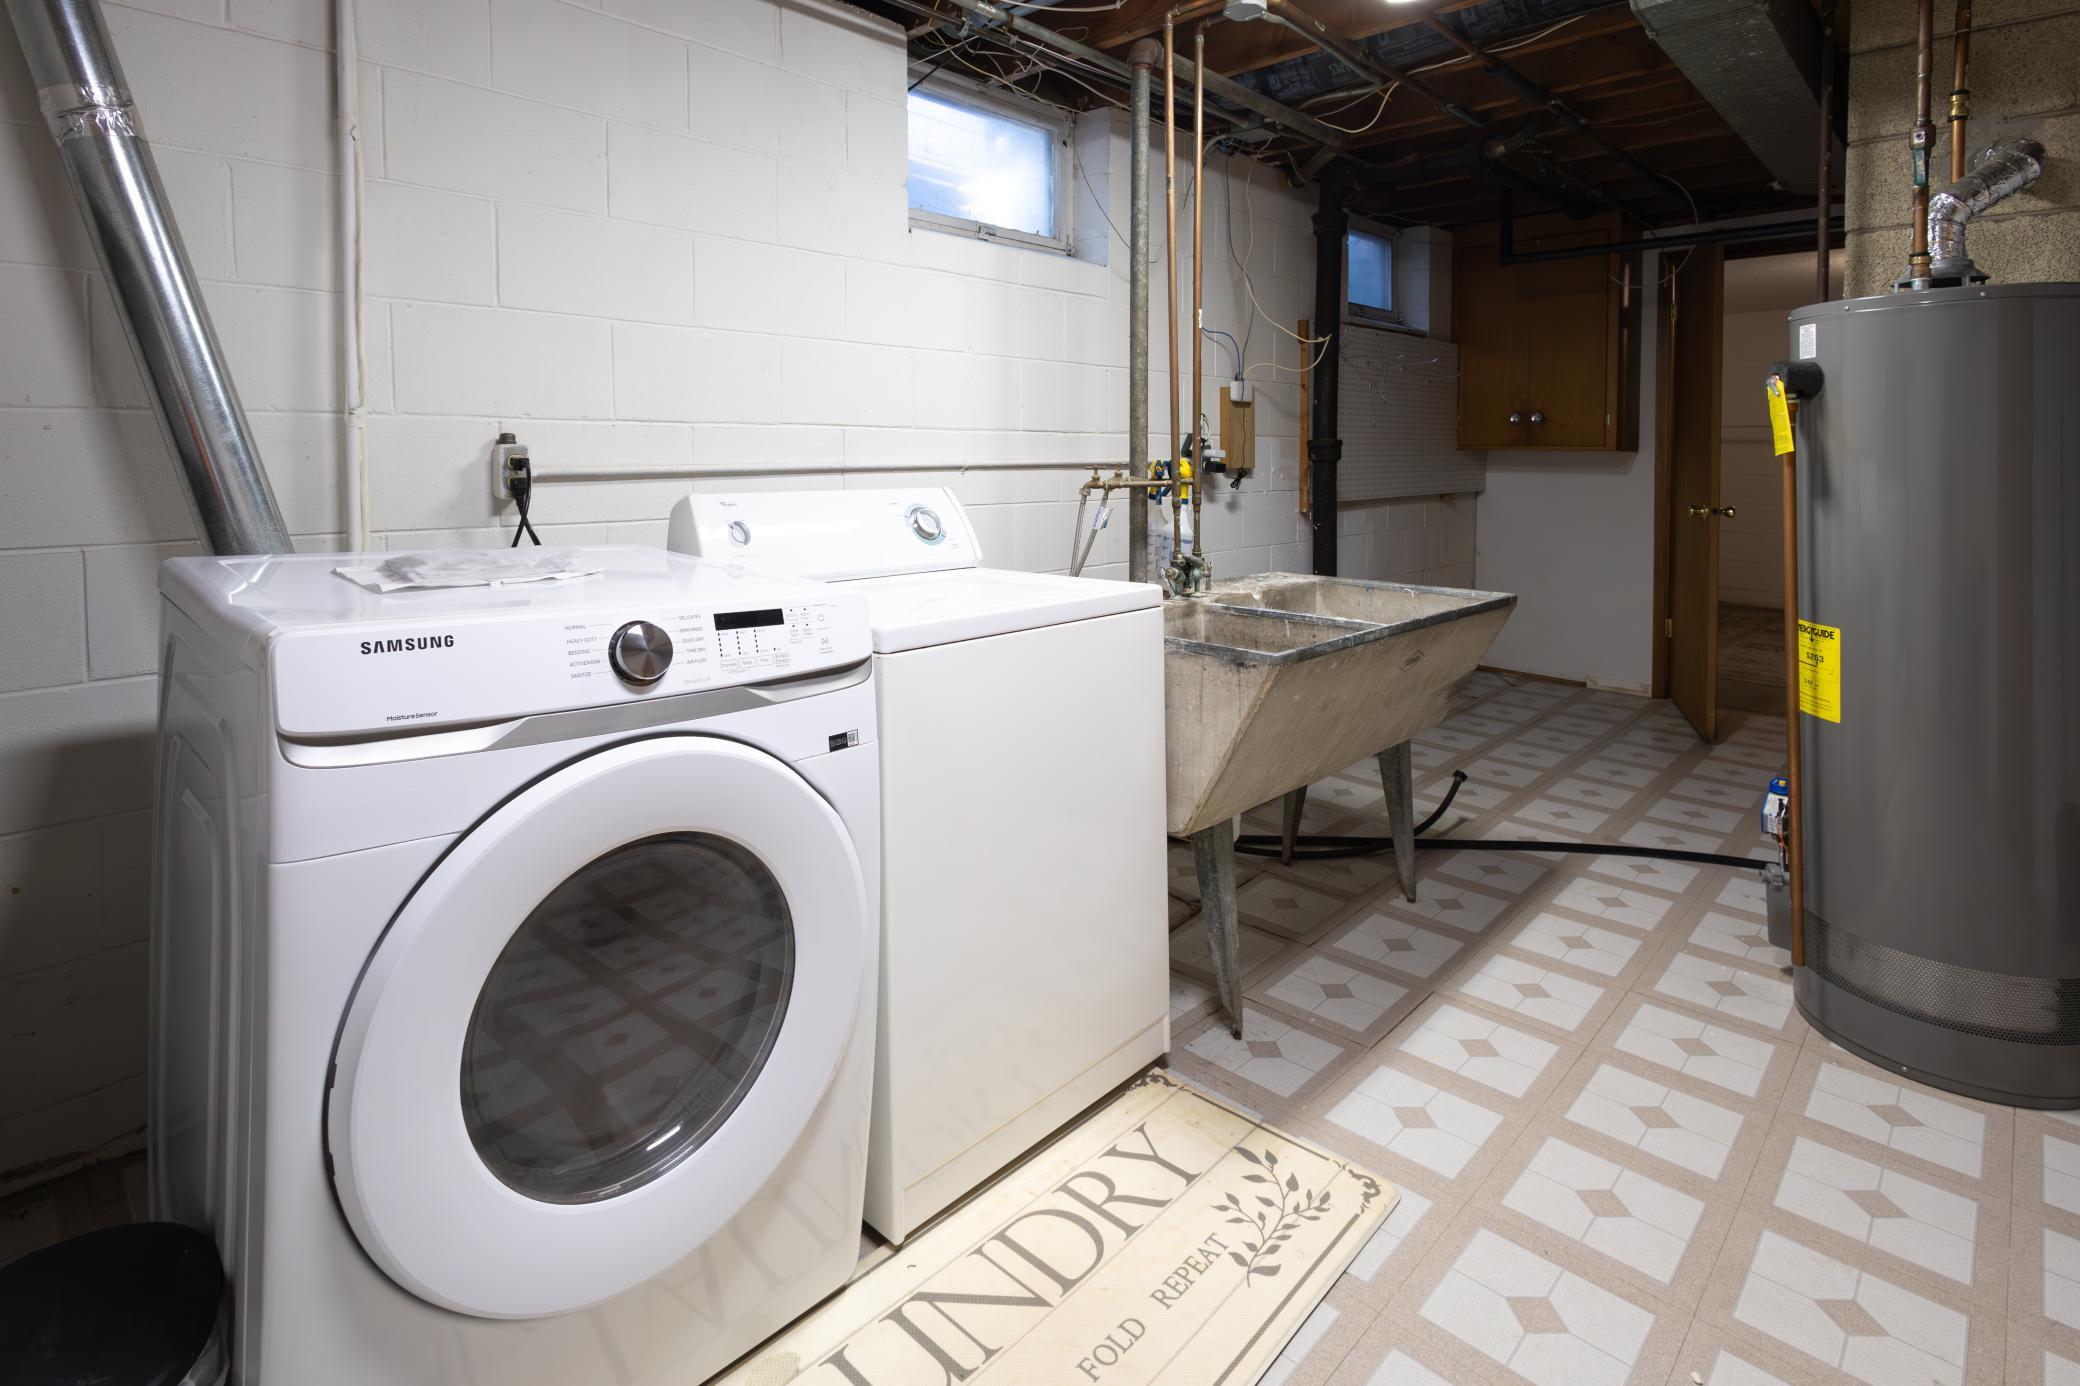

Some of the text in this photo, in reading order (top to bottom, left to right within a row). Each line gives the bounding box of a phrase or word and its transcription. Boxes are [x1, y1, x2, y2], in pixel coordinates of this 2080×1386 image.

[360, 635, 455, 655] SAMSUNG
[569, 659, 601, 667] ACTIVEWEAR
[386, 710, 439, 722] MoistureSensor
[1075, 1232, 1231, 1384] FOLD REPEAT
